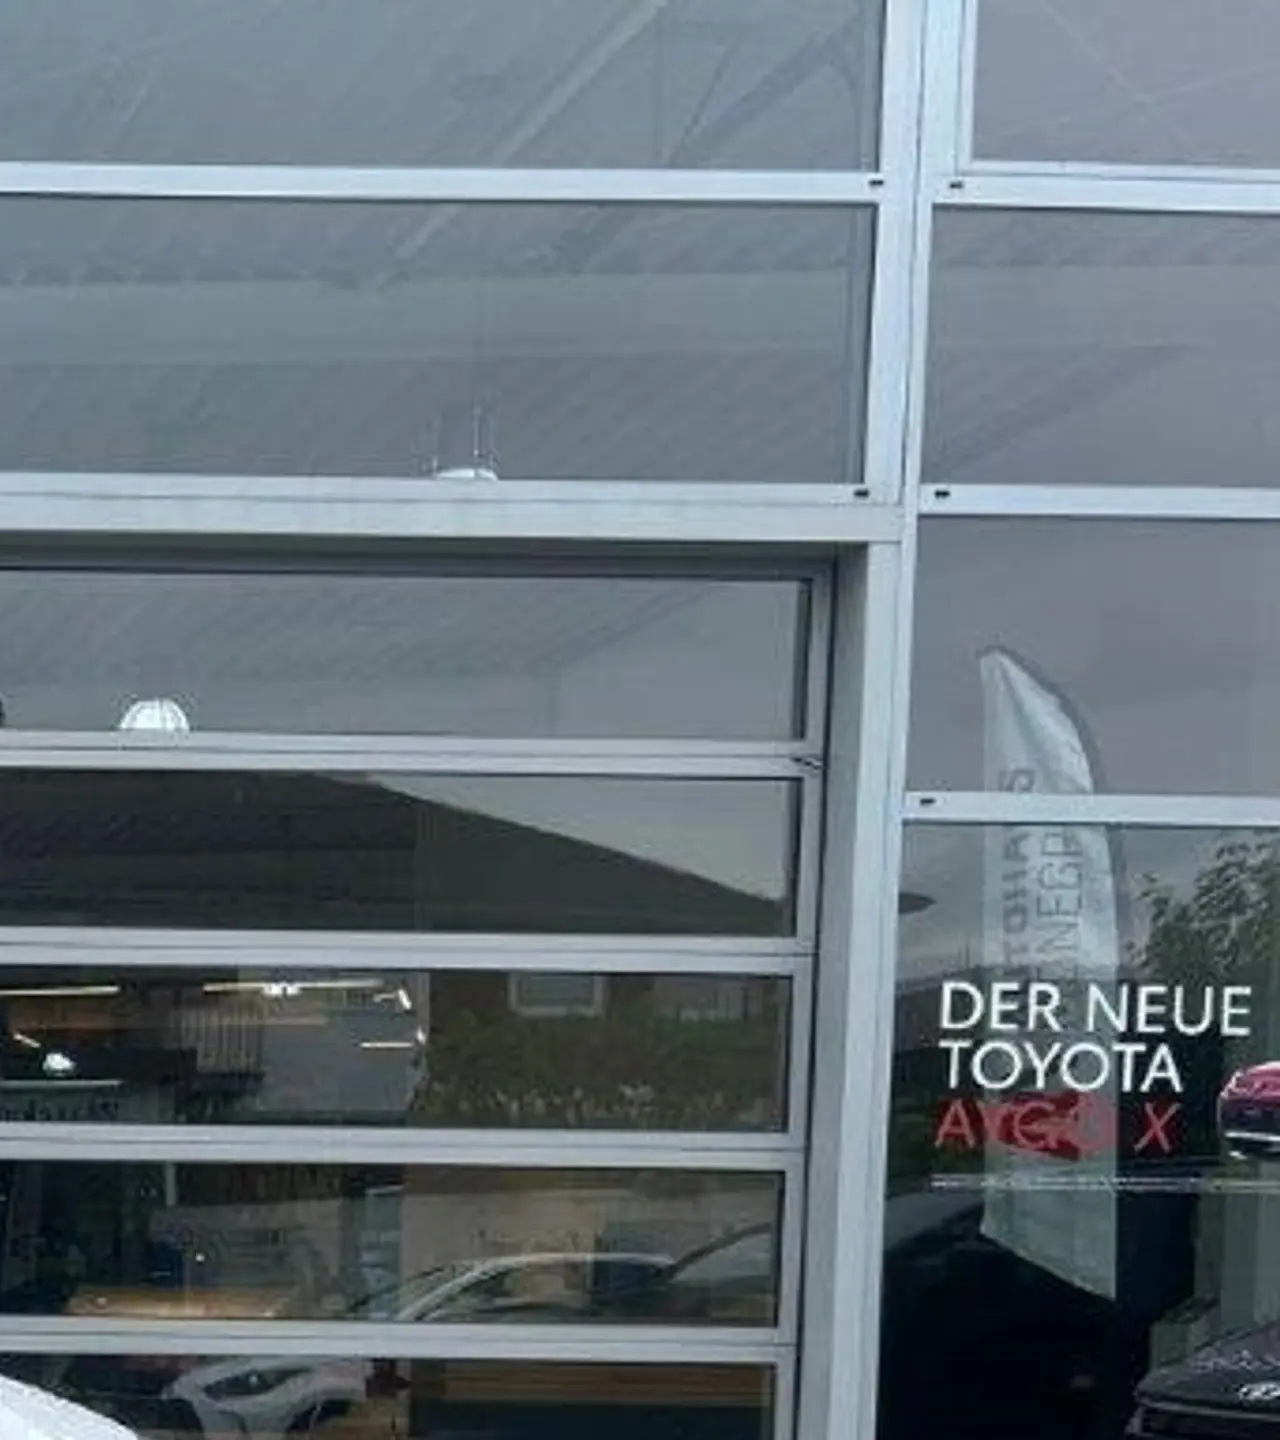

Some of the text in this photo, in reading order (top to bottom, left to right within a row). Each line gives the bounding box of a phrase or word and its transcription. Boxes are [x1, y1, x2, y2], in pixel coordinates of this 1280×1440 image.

[941, 981, 1252, 1036] DER NEUE
[938, 1039, 1184, 1092] TOYOTA
[935, 1098, 1180, 1152] AYGO X
